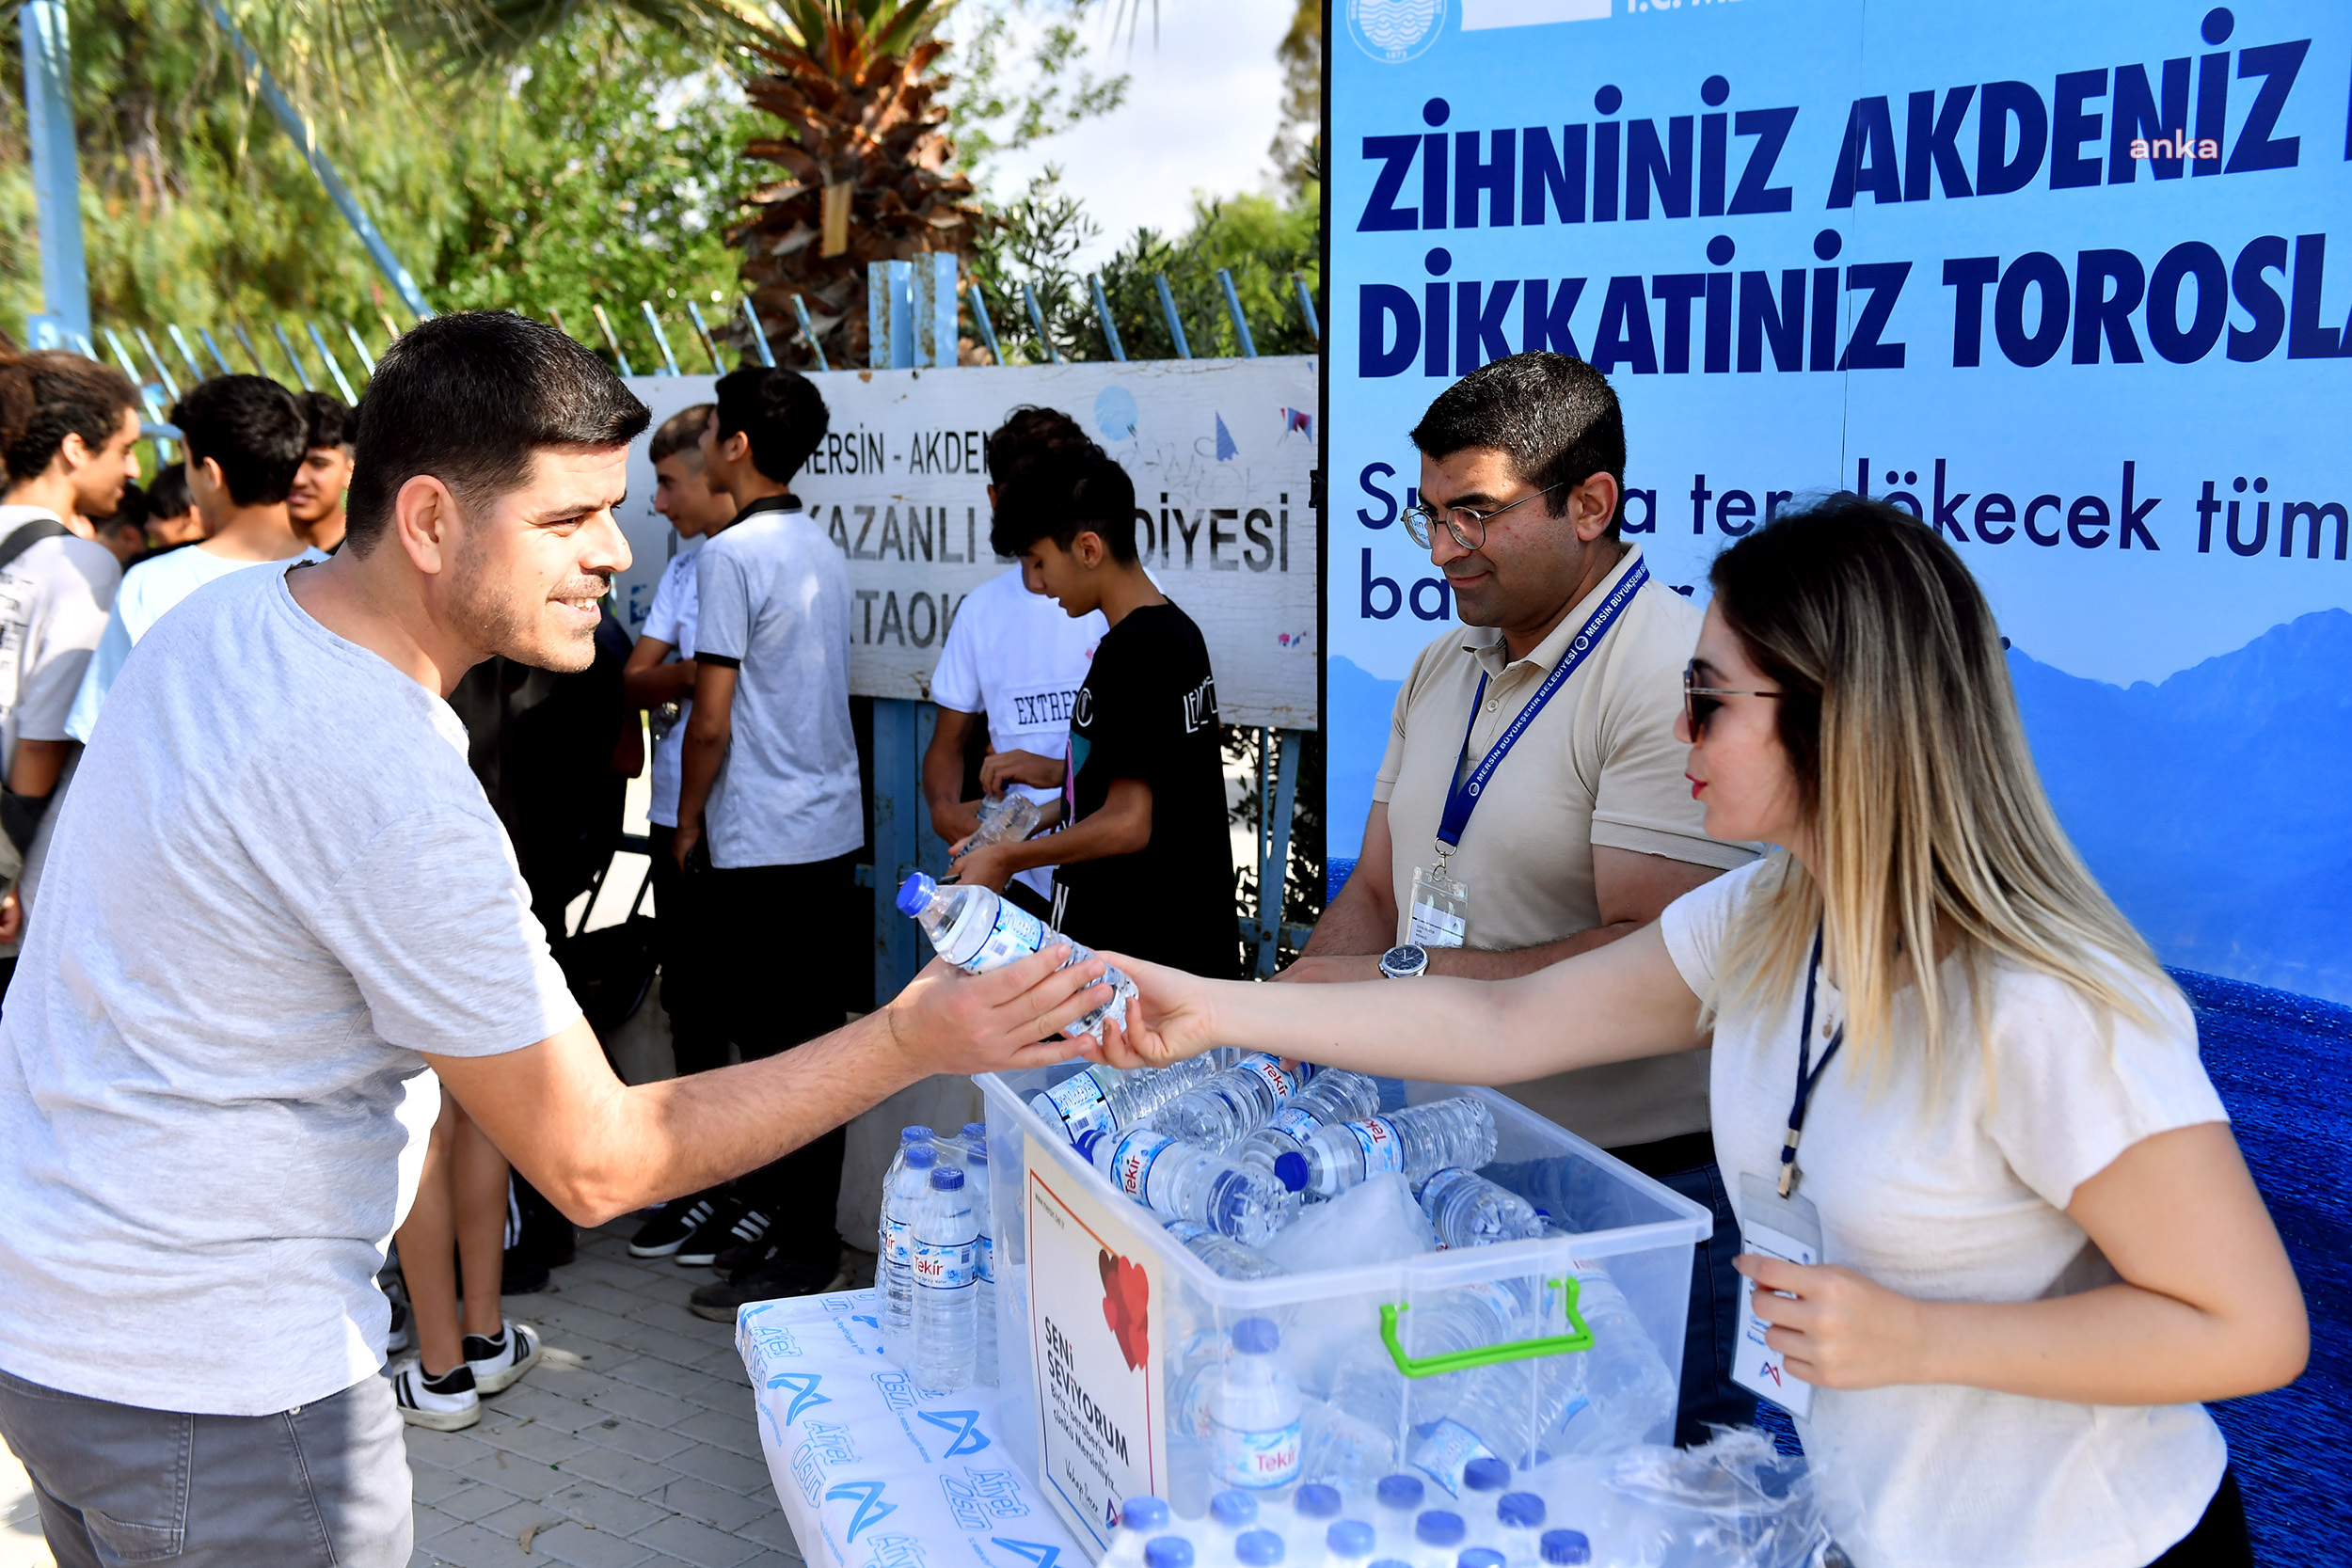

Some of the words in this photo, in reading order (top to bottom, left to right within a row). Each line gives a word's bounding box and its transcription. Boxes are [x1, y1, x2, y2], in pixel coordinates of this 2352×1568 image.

[1357, 74, 1799, 231] ZİHNİNİZ
[1826, 7, 2312, 209] AKDENİZ
[1359, 229, 1913, 378] DİKKATİNİZ
[1943, 232, 2352, 368] TOROSL
[804, 422, 883, 474] ERSİN
[810, 504, 976, 563] AZANLI
[2197, 477, 2349, 561] tüm
[1584, 606, 1613, 638] MERSİN
[1476, 749, 1502, 783] MERSİN
[1500, 696, 1541, 750] BÜYÜKŞEHİR
[1539, 648, 1579, 698] BELEDİYESİ
[914, 1256, 944, 1275] Tekir
